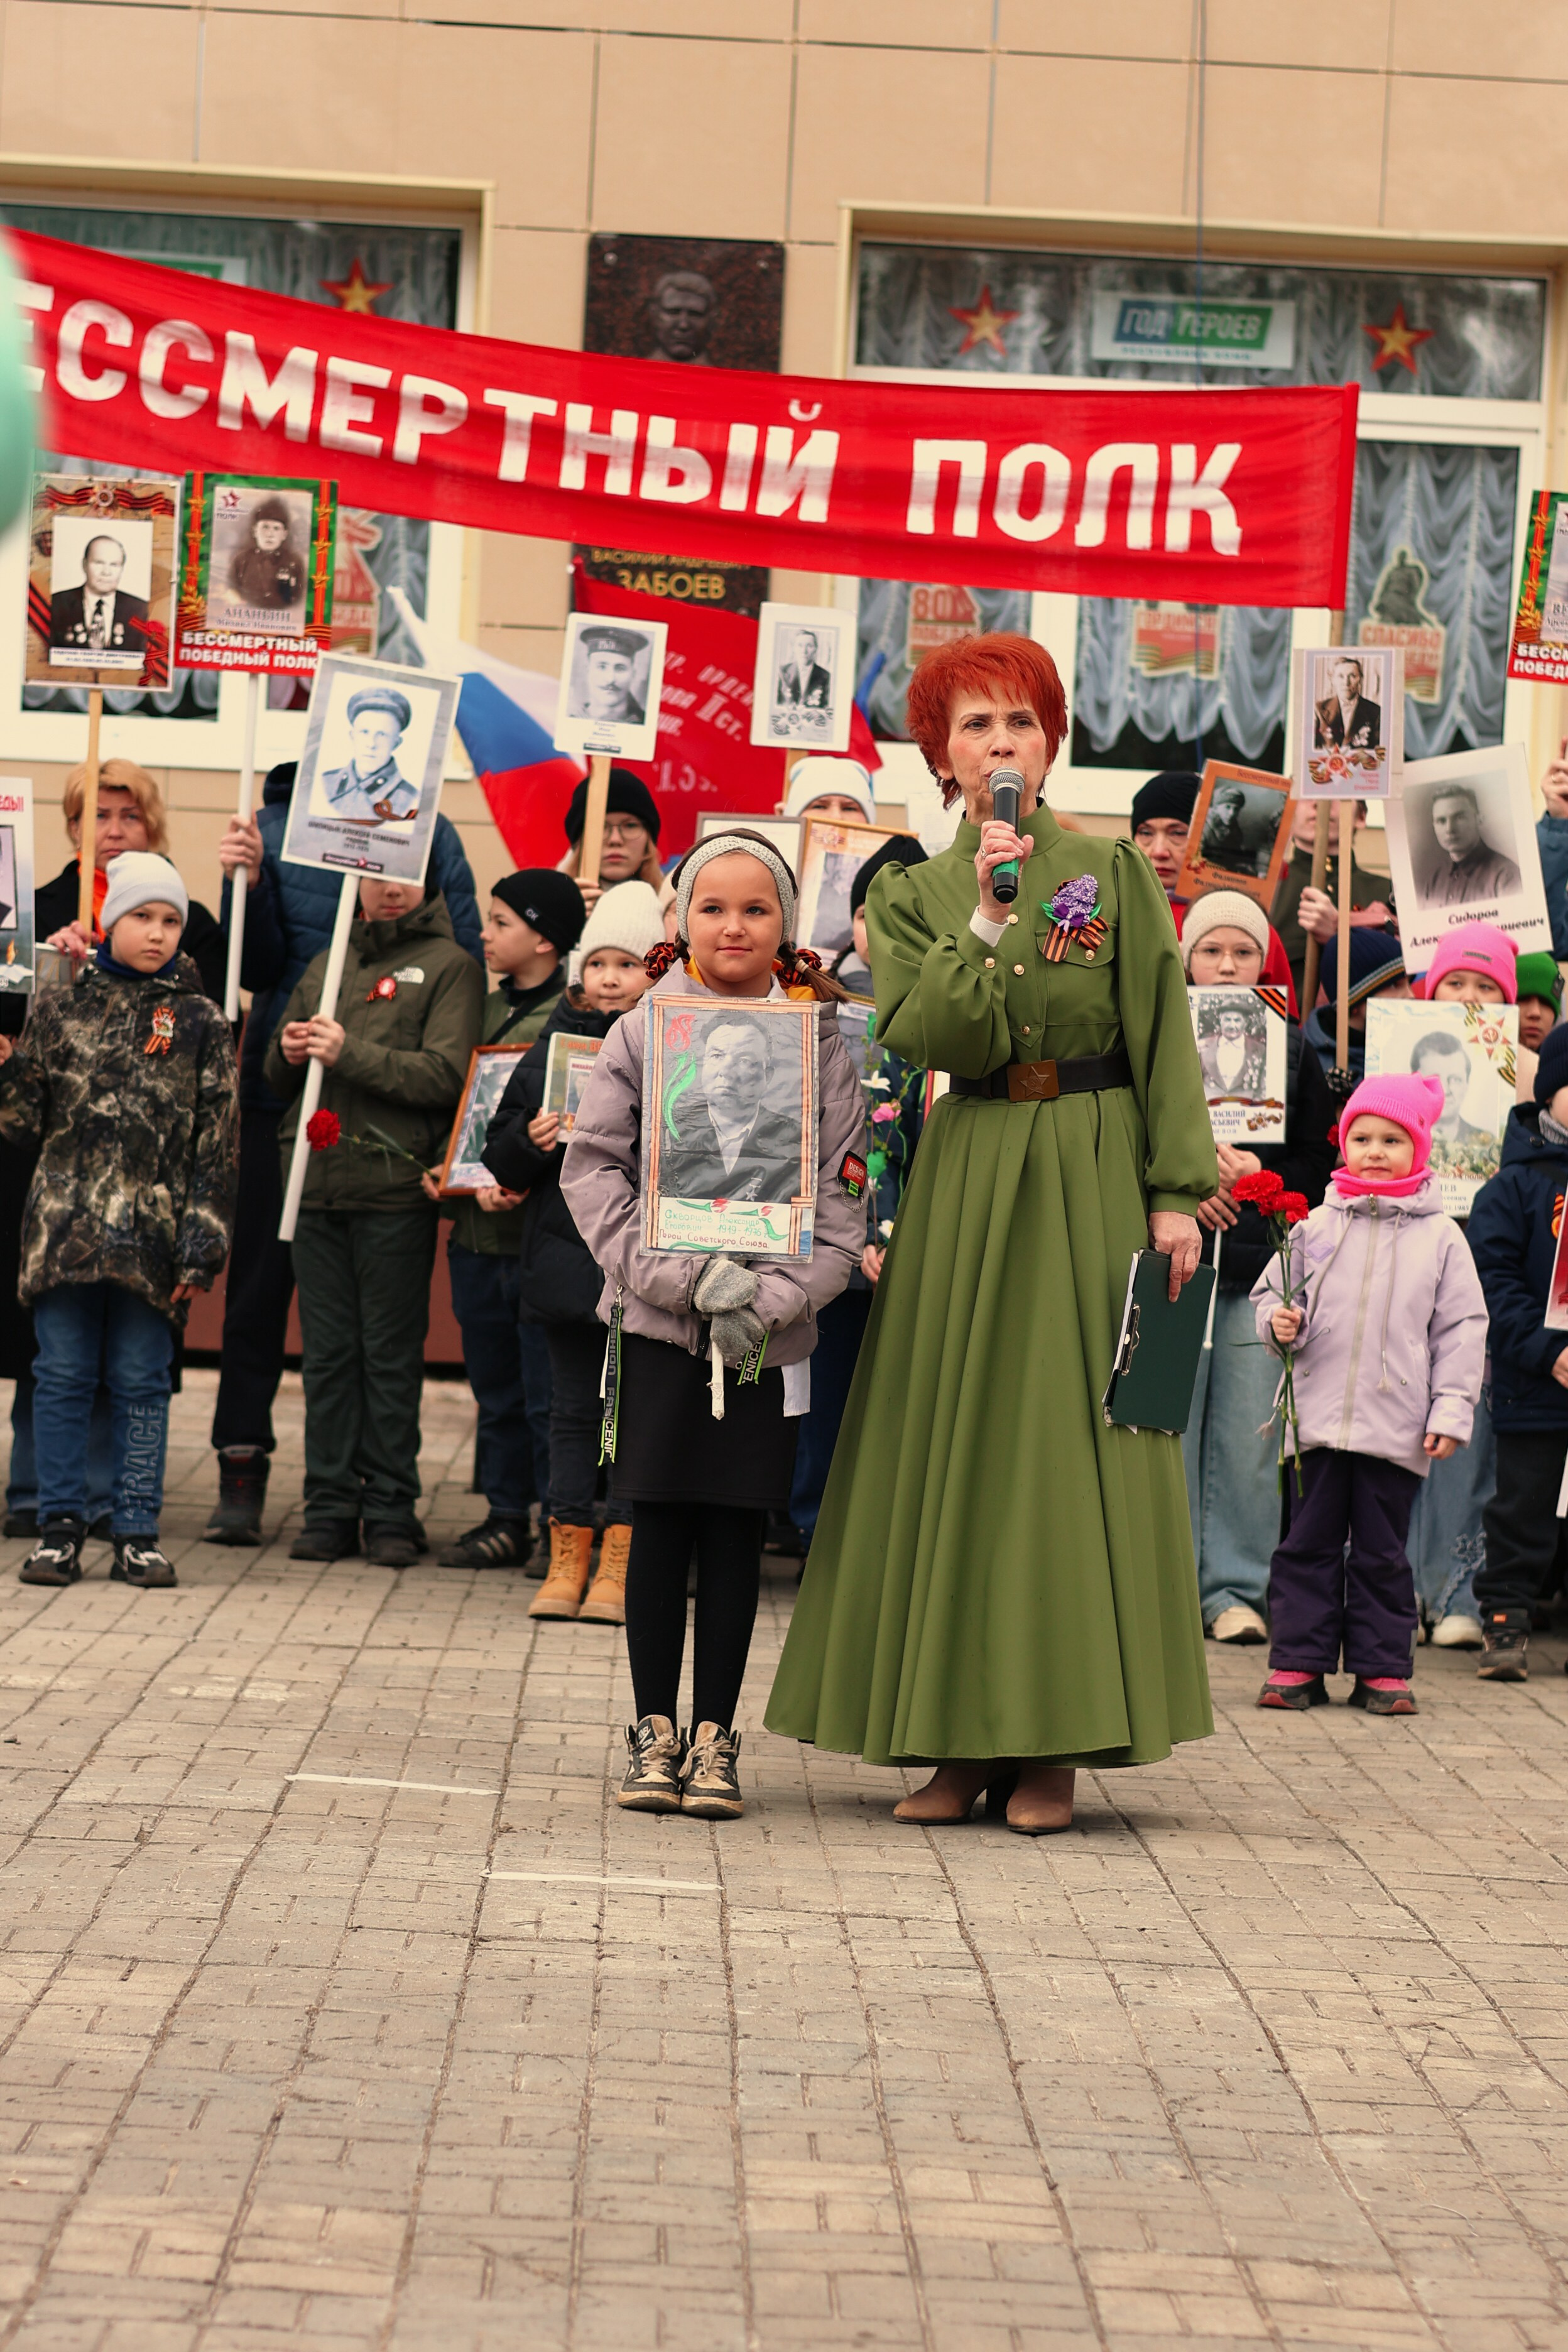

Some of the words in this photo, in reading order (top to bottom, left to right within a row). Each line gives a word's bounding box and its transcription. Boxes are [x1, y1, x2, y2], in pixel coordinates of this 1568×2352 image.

[1123, 308, 1168, 340] ГОД
[1178, 309, 1262, 340] ГЕРОЕВ
[9, 278, 841, 523] ЕССМЕРТНЫЙ
[906, 438, 1243, 557] ПОЛК
[616, 569, 727, 600] ЗАБОЕВ
[224, 607, 291, 622] АНАНЬИН
[182, 631, 318, 653] БЕССМЕРТНЫЙ
[179, 648, 270, 667] ПОБЕДНЫЙ
[273, 653, 318, 670] ПОЛК
[665, 650, 687, 674] ТР.
[1513, 658, 1568, 680] ПОБЕД
[372, 832, 410, 847] СЕМЕНОВИЧ
[1447, 909, 1499, 925] Сидоров
[1410, 934, 1440, 948] Алек
[1213, 1109, 1246, 1118] ВАСИЛИЙ
[849, 1162, 864, 1178] DESIGN
[665, 1209, 714, 1224] Скворцов
[719, 1213, 760, 1227] Александр
[665, 1221, 702, 1231] Егорович
[659, 1228, 682, 1240] Герой
[687, 1232, 737, 1247] Советского
[607, 1309, 621, 1376] FASHION
